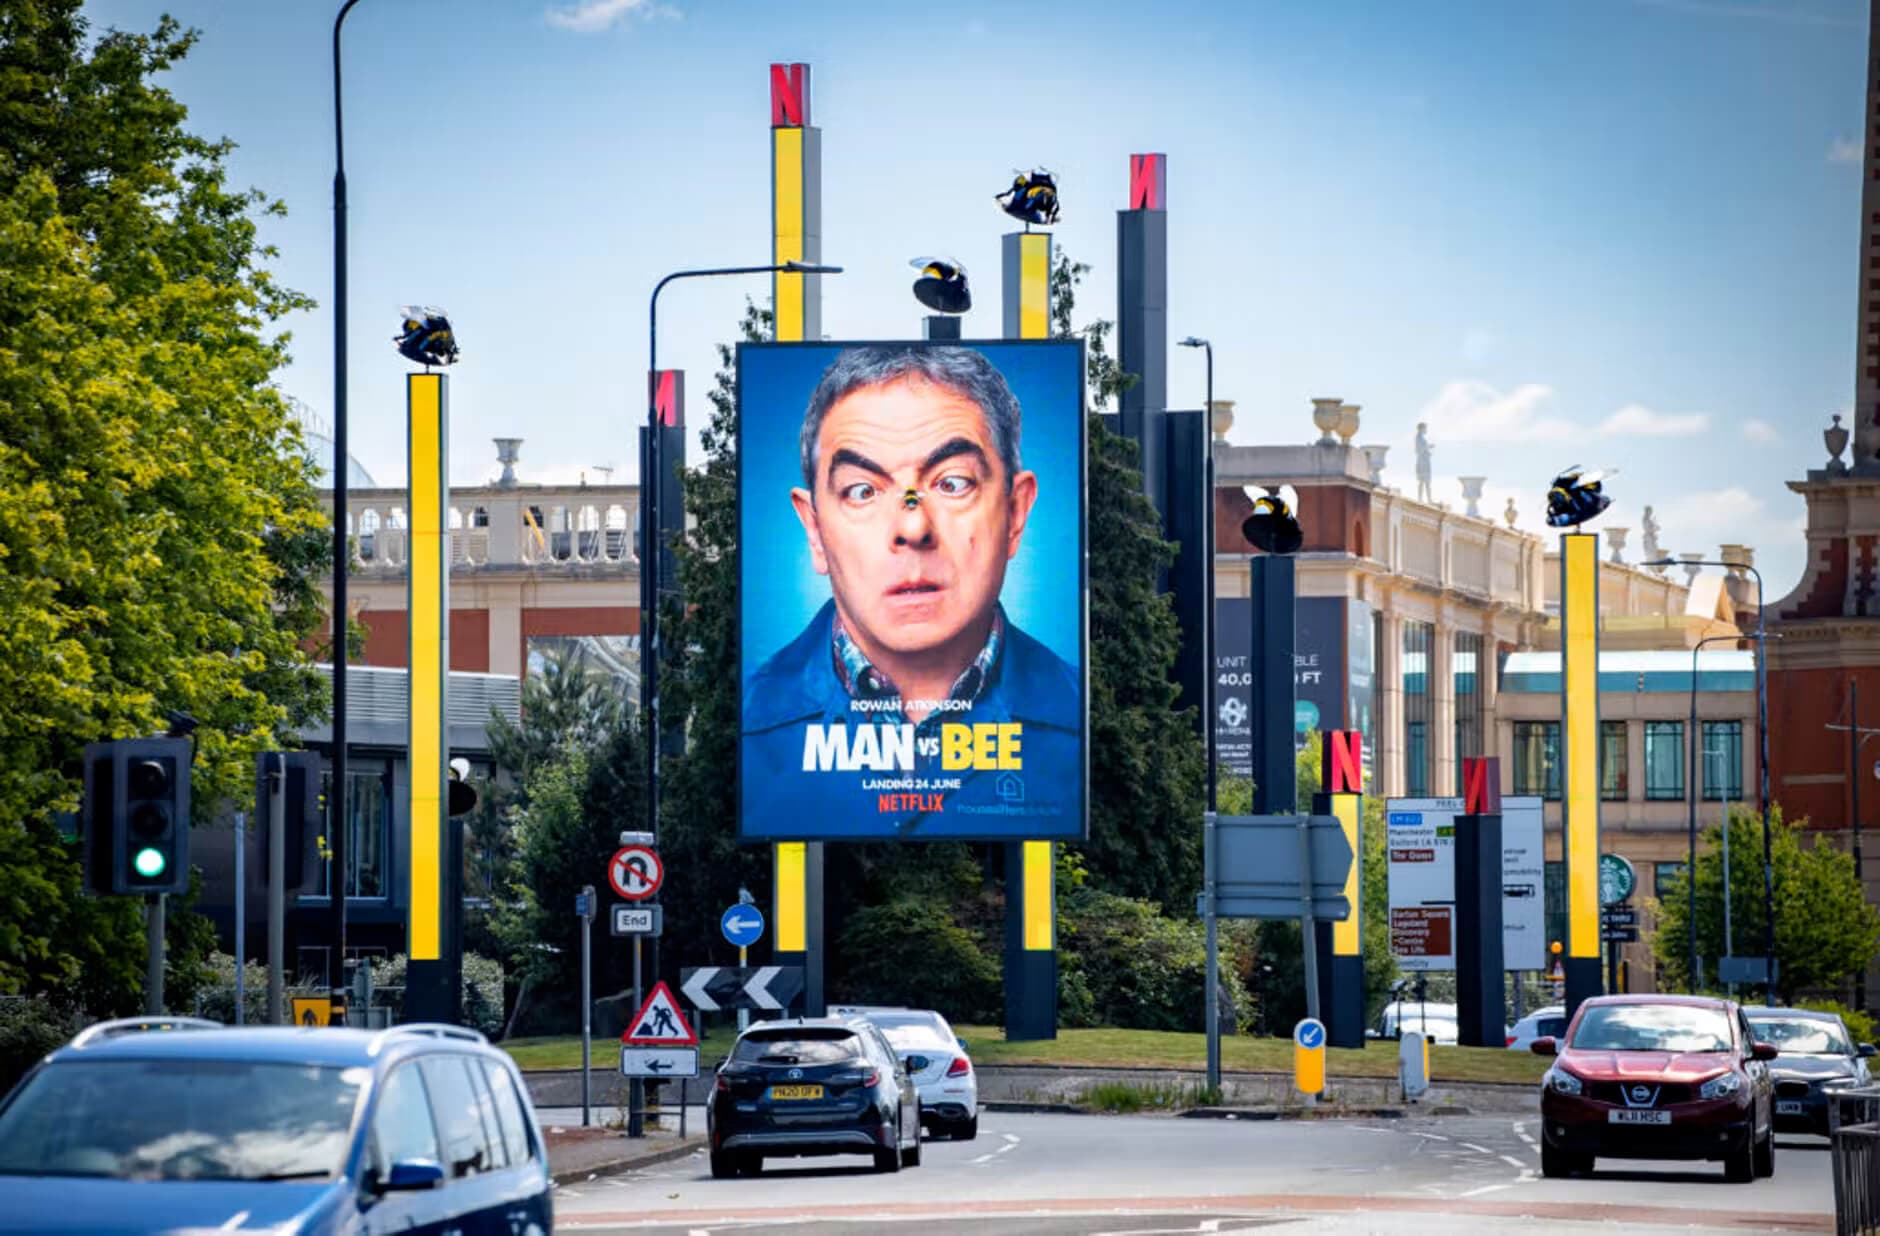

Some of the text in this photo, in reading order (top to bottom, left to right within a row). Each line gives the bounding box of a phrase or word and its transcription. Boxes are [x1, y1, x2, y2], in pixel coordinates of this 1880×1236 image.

[770, 63, 804, 127] N
[850, 699, 973, 712] ROWAN ATKINSON
[802, 723, 915, 772] MAN
[942, 723, 1023, 771] BEE
[1332, 730, 1362, 793] N
[862, 779, 962, 790] LANDING 24 JUNE
[878, 793, 945, 813] NETFLIX
[622, 914, 648, 926] End
